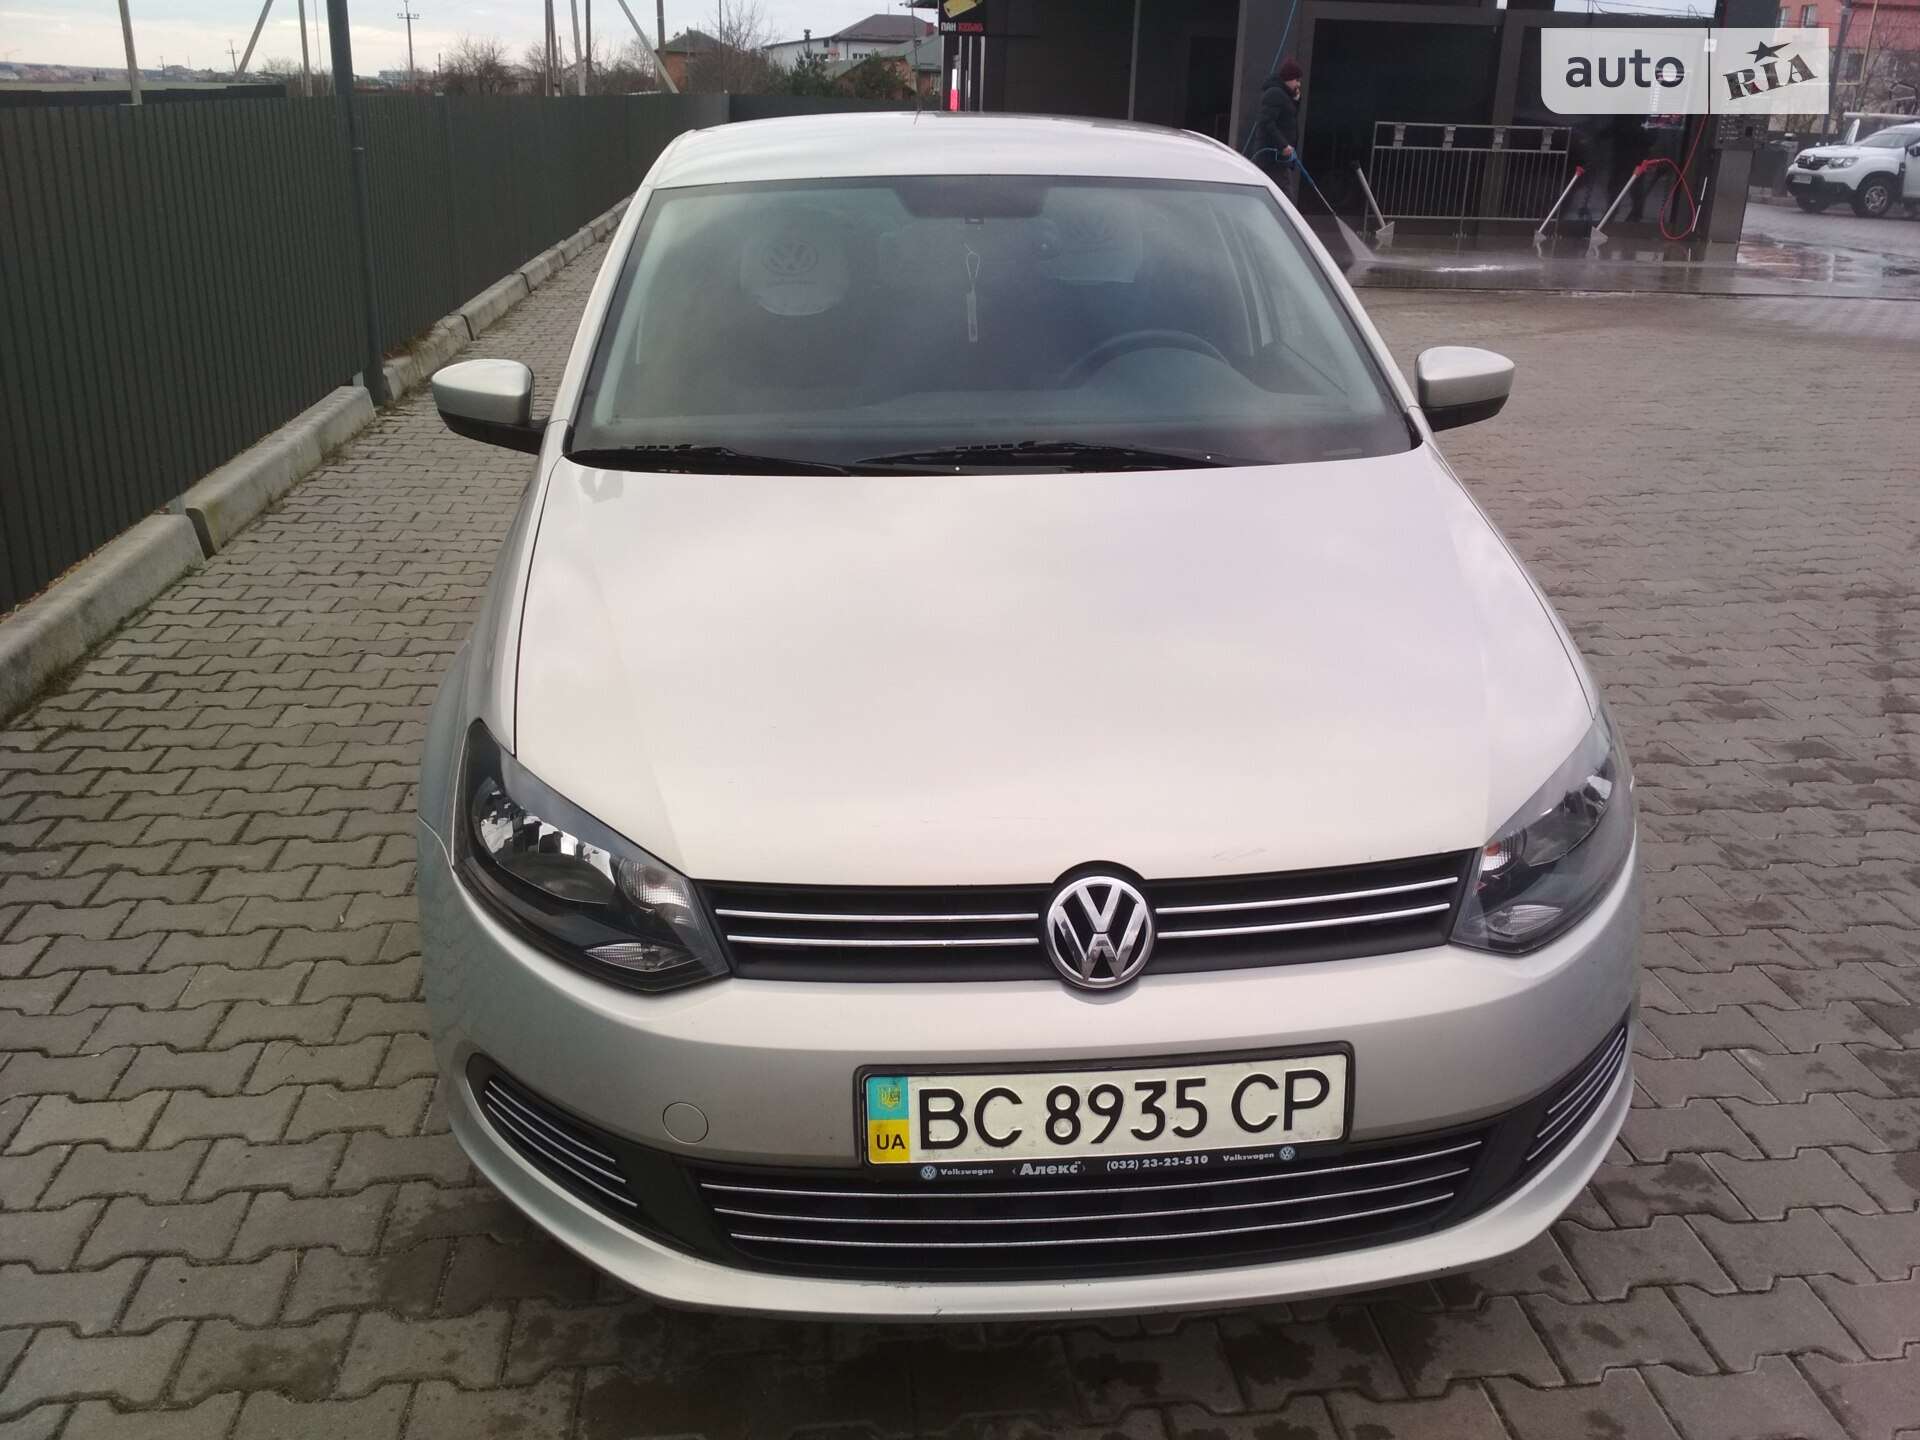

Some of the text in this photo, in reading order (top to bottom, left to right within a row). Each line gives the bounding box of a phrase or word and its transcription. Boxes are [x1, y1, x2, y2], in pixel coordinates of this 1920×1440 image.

[919, 1069, 1330, 1150] BC 8935 CP
[876, 1133, 906, 1150] UA
[1106, 1155, 1209, 1171] (032) 23-23-510
[1223, 1151, 1275, 1163] Volkswagen
[940, 1167, 994, 1177] Volkswagen
